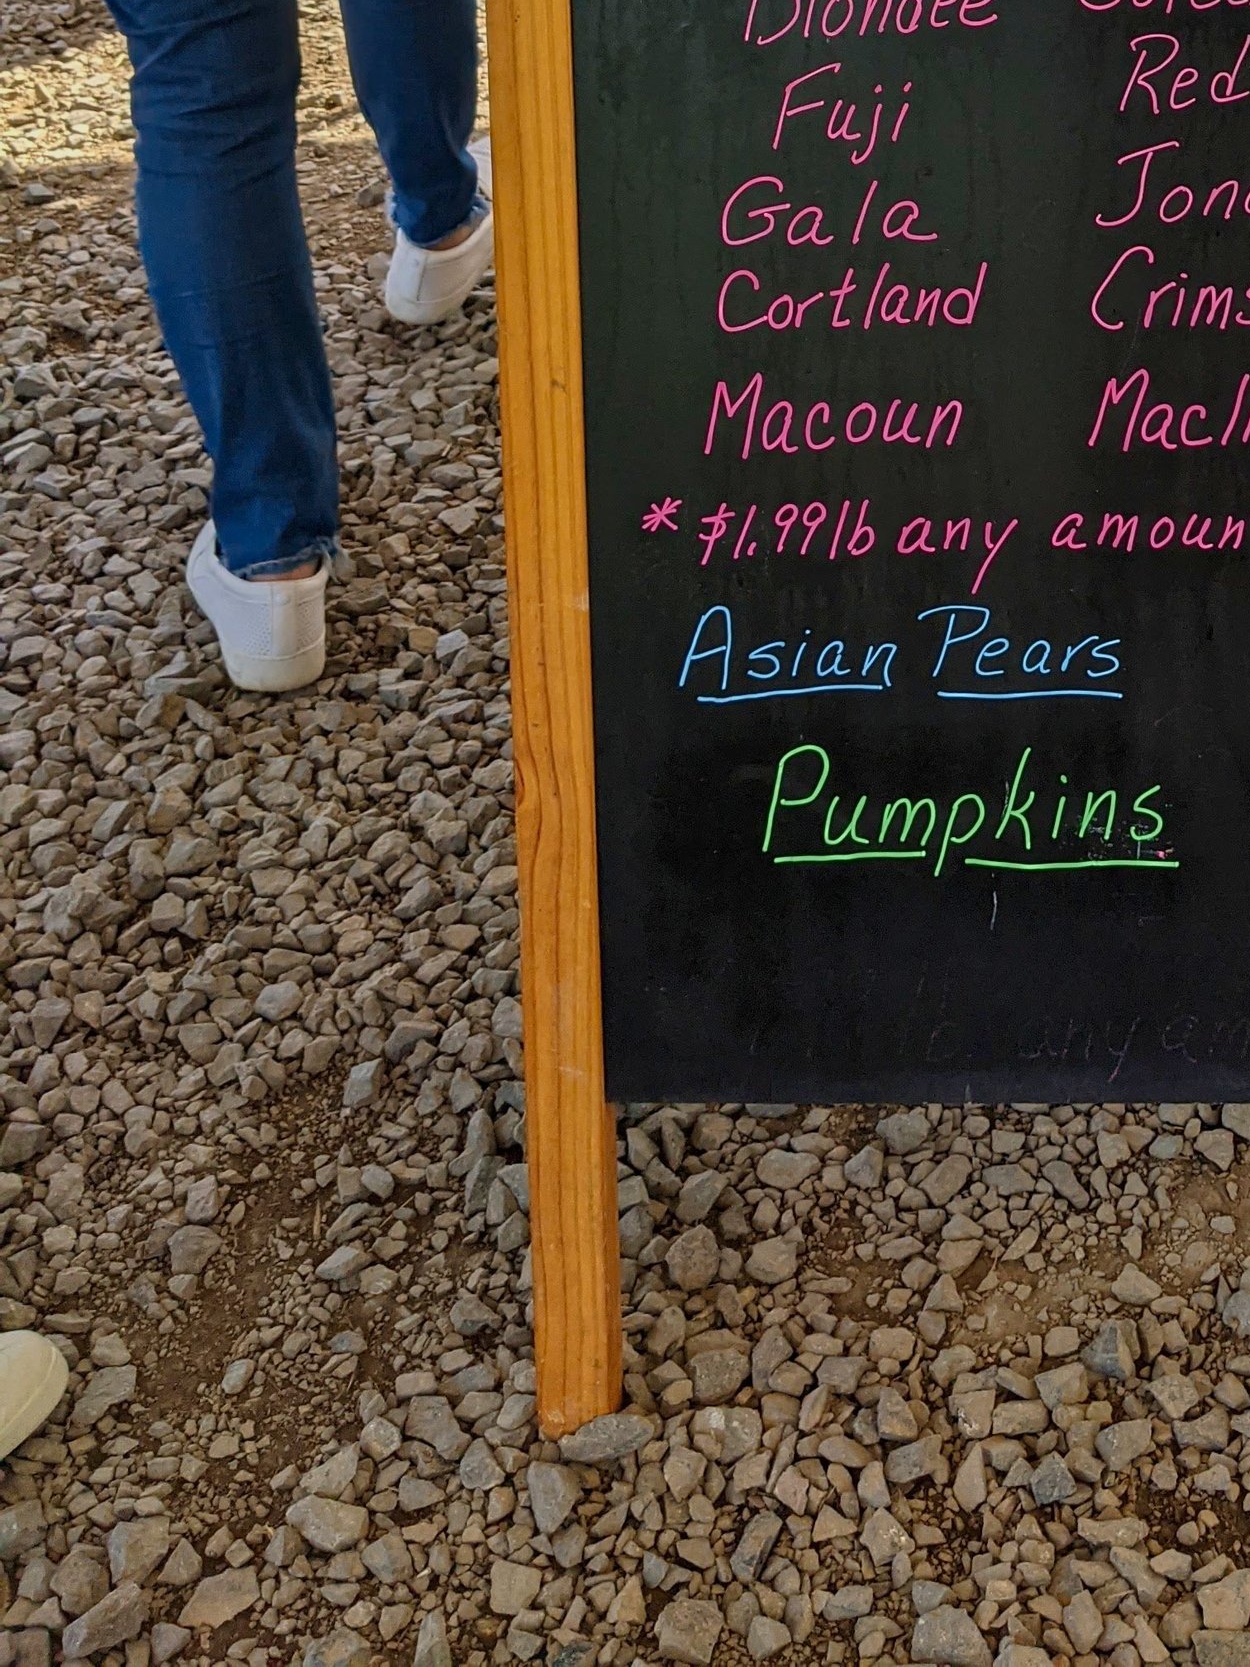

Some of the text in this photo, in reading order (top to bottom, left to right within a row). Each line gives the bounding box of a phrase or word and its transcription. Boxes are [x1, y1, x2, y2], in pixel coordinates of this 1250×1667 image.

[773, 63, 912, 164] Fuji
[722, 176, 938, 245] Gala
[718, 262, 987, 332] Cortland
[704, 373, 964, 456] Macoun
[897, 514, 1019, 594] any
[679, 606, 1122, 697] Asian Pears
[762, 745, 1177, 875] Pumpkins
